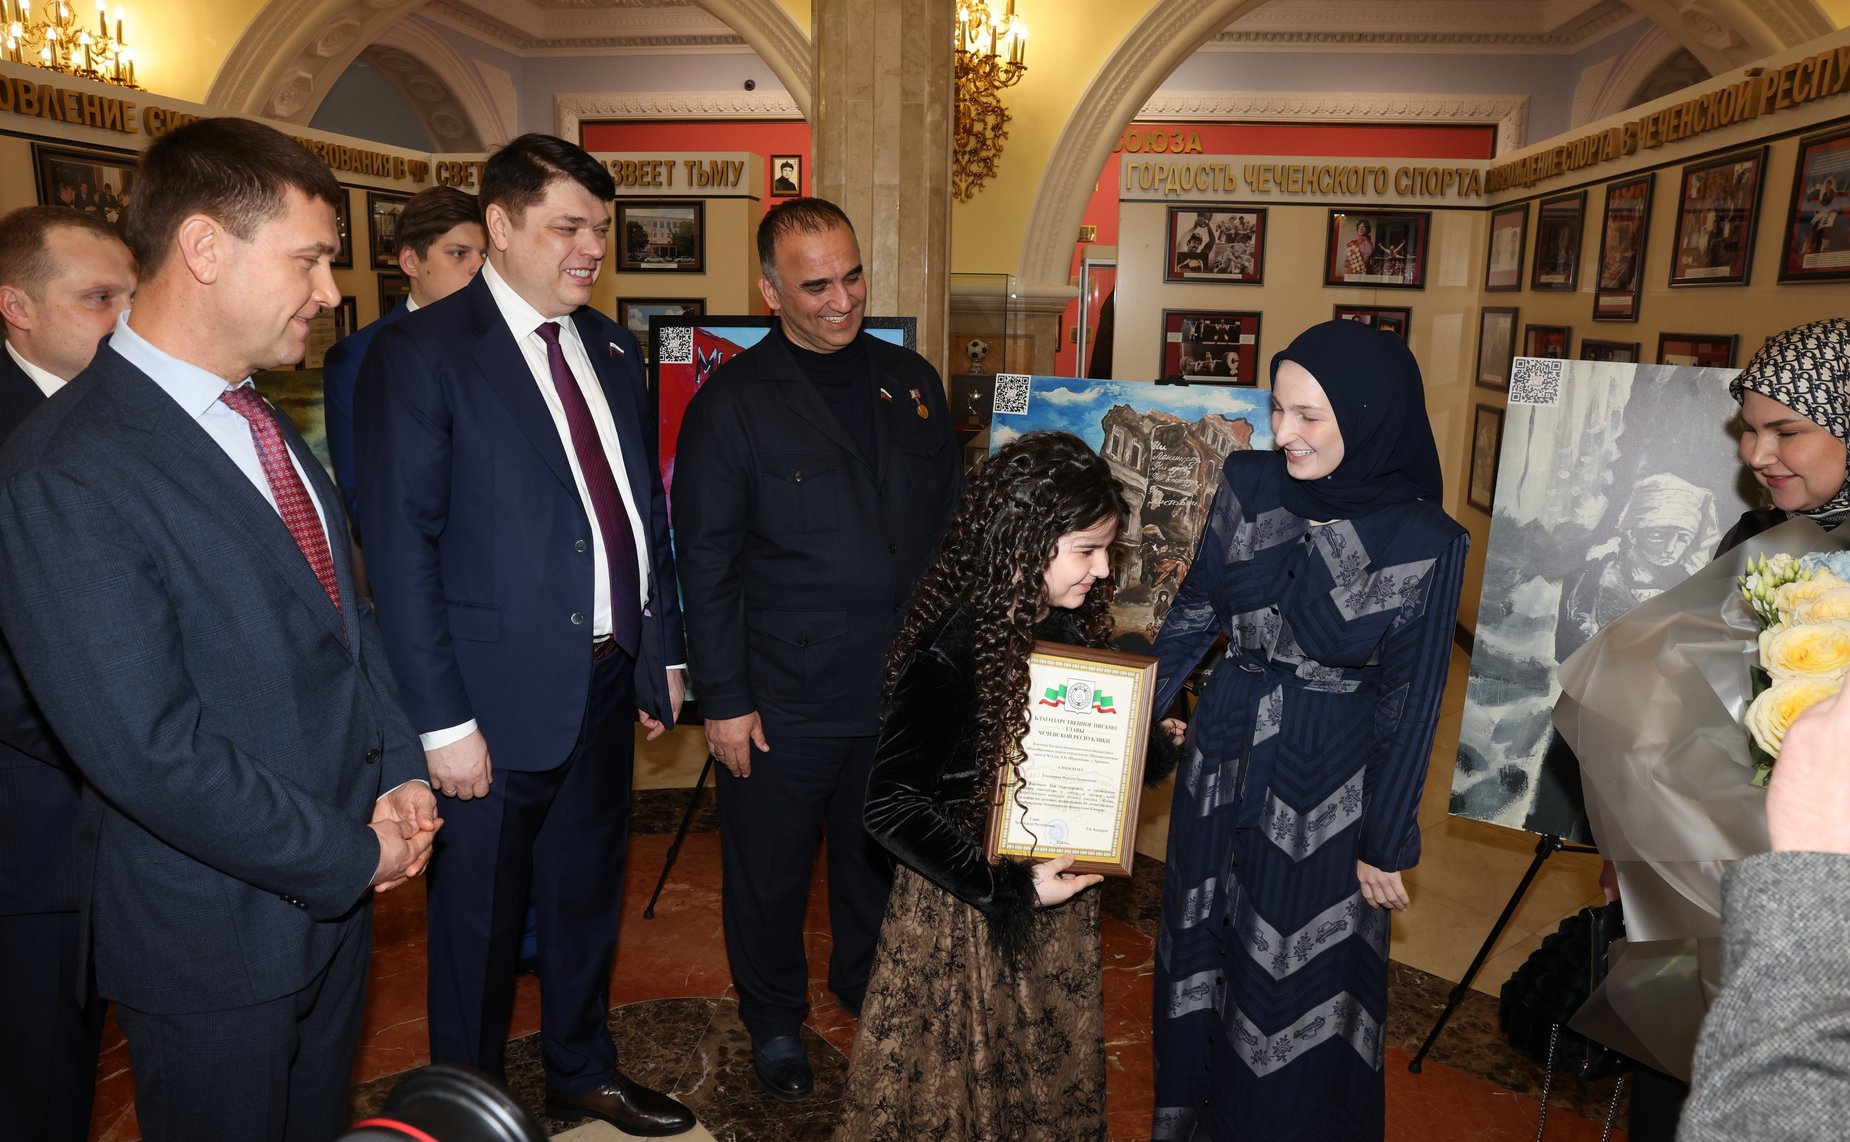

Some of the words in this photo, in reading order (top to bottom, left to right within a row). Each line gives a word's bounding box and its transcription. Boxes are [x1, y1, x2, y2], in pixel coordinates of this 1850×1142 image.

[1564, 127, 1621, 172] СПОРТА
[1620, 121, 1639, 156] В
[1638, 67, 1765, 150] ЧЕЧЕНСКОЙ
[684, 160, 744, 187] ТЬМУ
[1126, 161, 1238, 196] ГОРДОСТЬ
[1243, 163, 1390, 195] ЧЕЧЕНСКОГО
[1394, 166, 1483, 197] СПОРТА
